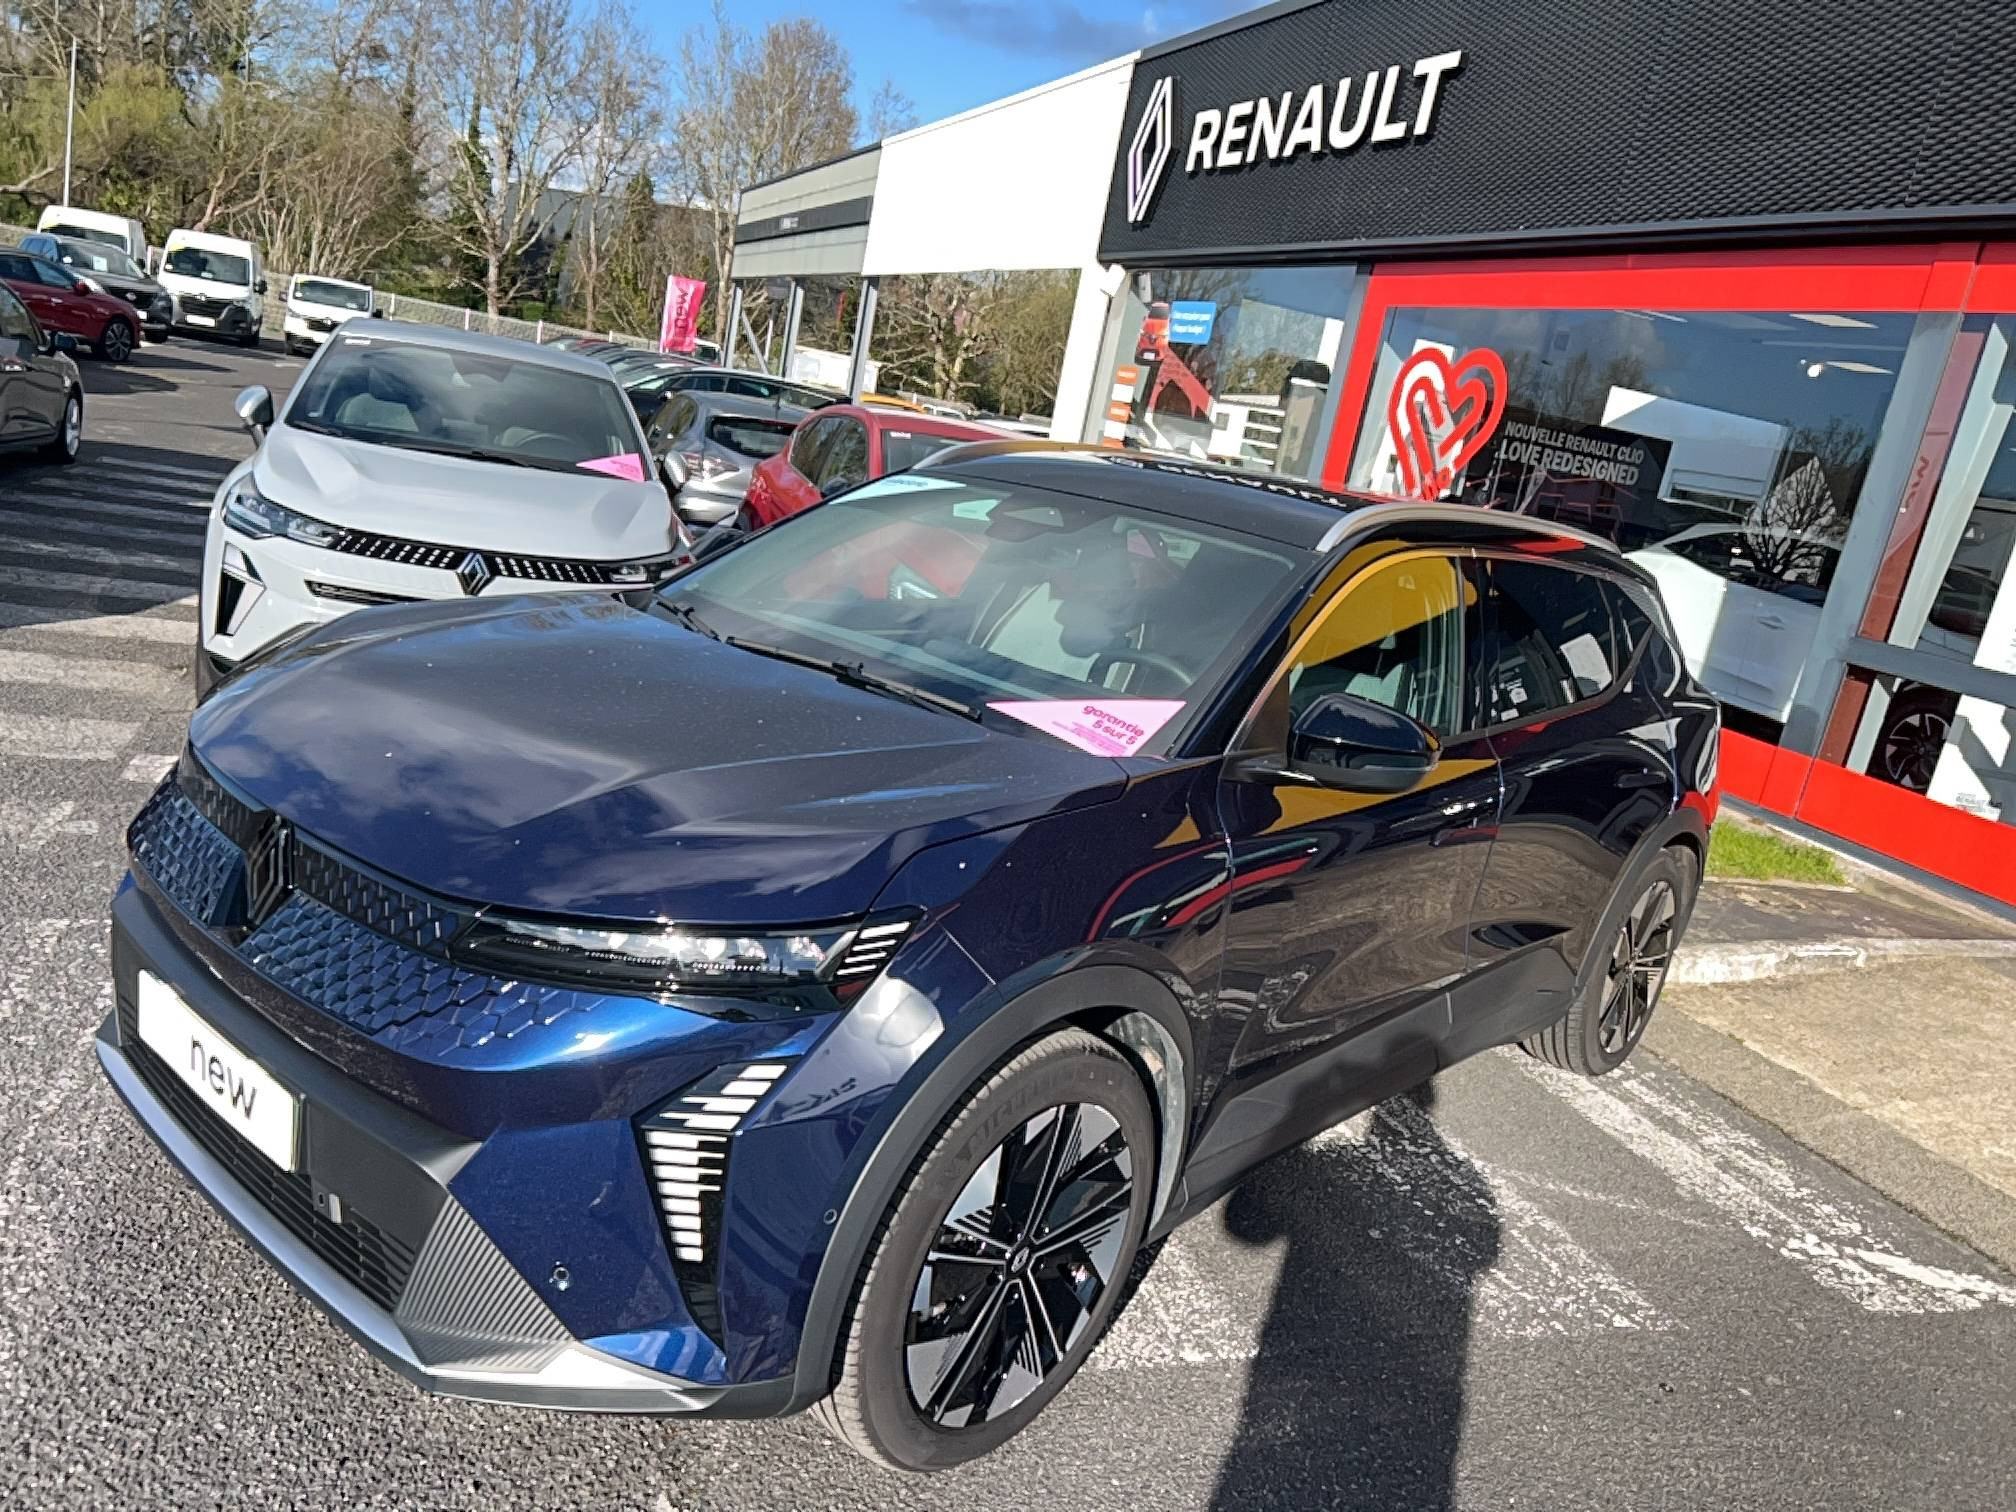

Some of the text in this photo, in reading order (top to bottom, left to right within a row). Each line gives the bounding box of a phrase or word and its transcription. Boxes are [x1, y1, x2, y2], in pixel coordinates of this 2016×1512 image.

[1185, 50, 1463, 172] RENAULT
[1499, 439, 1639, 486] LOVE REDESIGNED
[1504, 421, 1645, 464] NOUVELLE RENAULT CLIO
[1082, 706, 1144, 736] garantie
[1102, 726, 1127, 739] sur
[1127, 735, 1137, 744] 5
[190, 1034, 257, 1121] new
